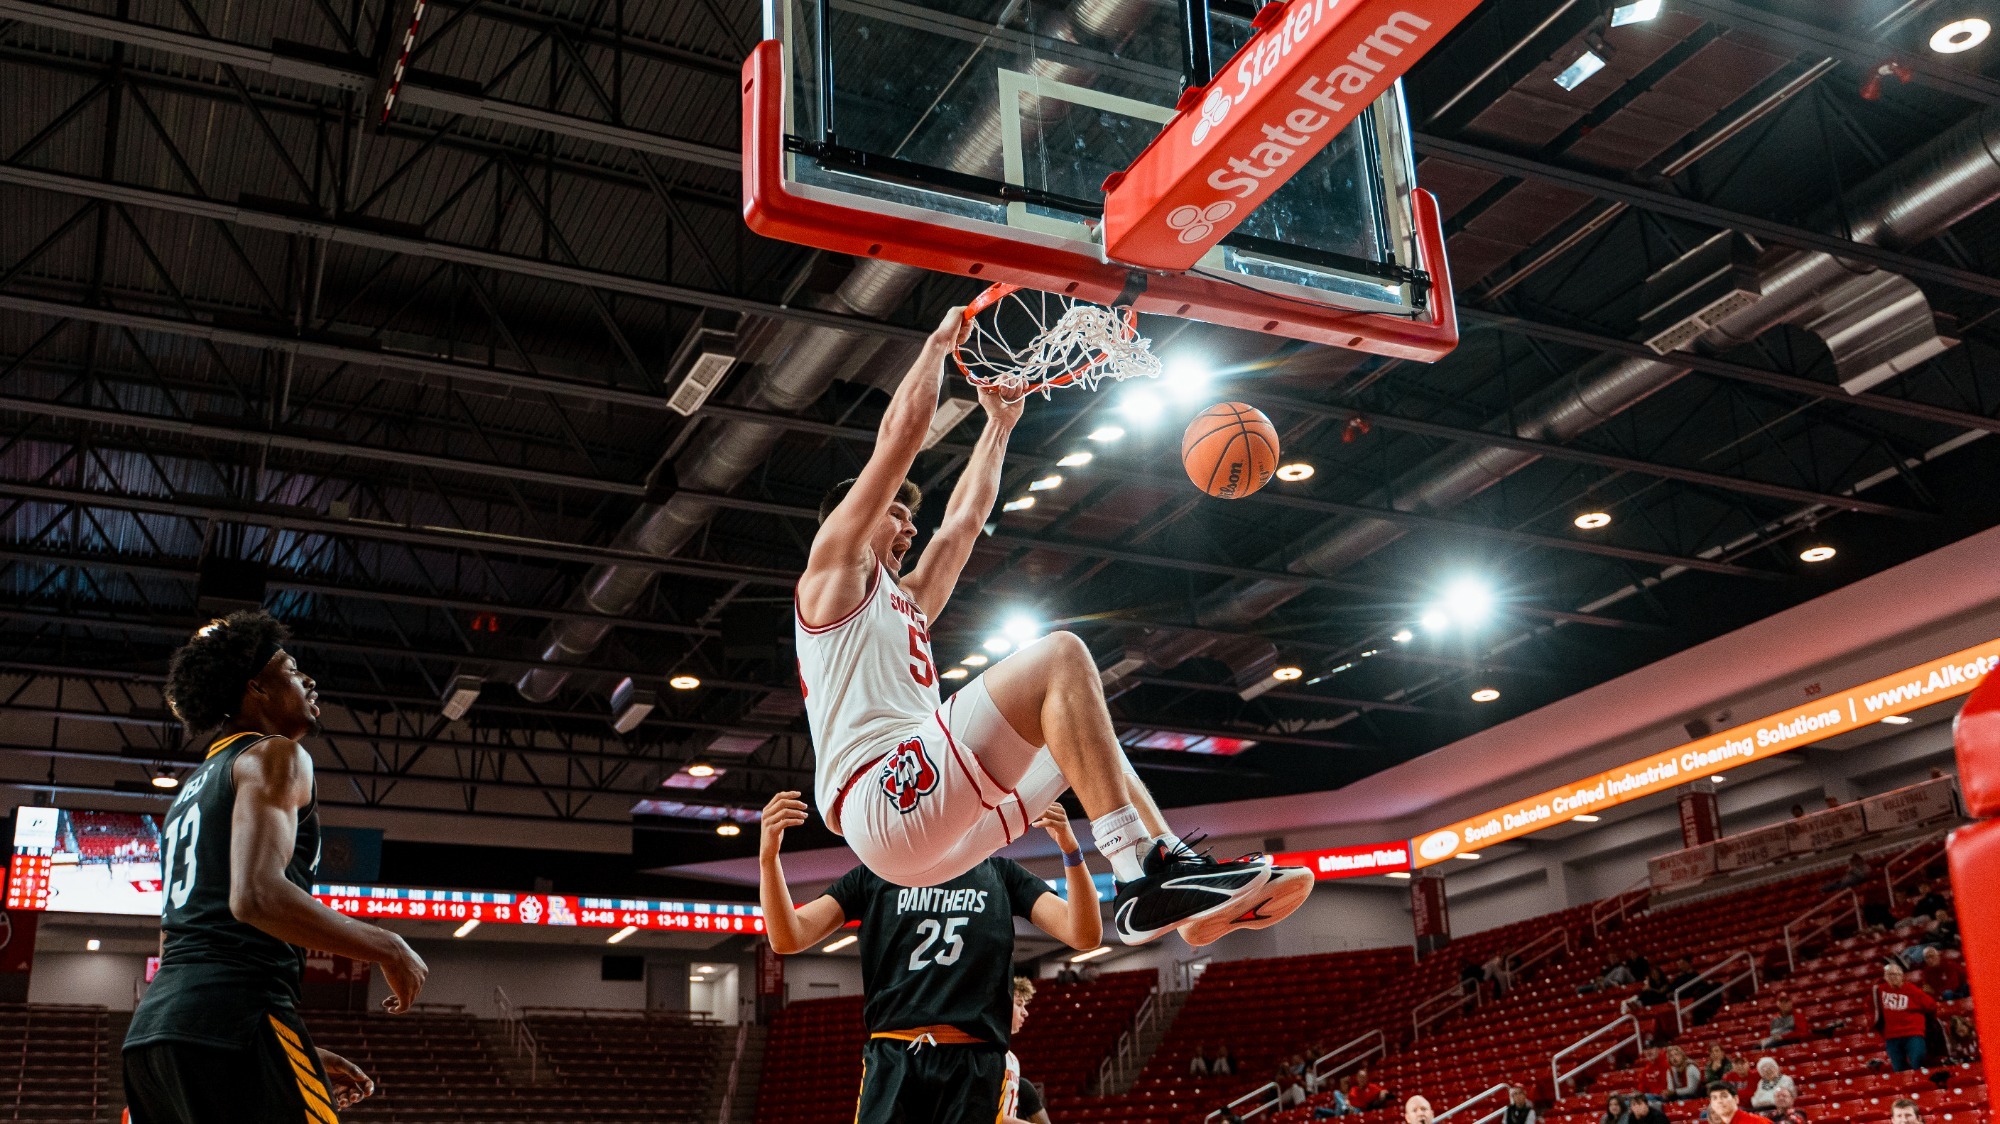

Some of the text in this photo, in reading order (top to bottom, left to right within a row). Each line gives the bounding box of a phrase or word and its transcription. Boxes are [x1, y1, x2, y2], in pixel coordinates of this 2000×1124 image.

[1464, 818, 1501, 843] South
[1503, 805, 1551, 831] Dakota
[1552, 783, 1606, 814] Crafted
[1608, 758, 1679, 797] Industrial
[1681, 737, 1755, 772] Cleaning
[1757, 708, 1842, 748] Solutions
[163, 802, 201, 912] 13
[366, 901, 403, 914] 34-44
[432, 903, 446, 917] 11
[450, 904, 466, 918] 10
[472, 905, 482, 918] 3
[494, 906, 510, 919] 13
[897, 887, 988, 915] PANTHERS
[622, 912, 649, 926] 4-13
[657, 914, 689, 927] 13-18
[694, 916, 709, 929] 31
[714, 917, 729, 930] 10
[908, 917, 970, 971] 25
[1881, 990, 1909, 1011] USD
